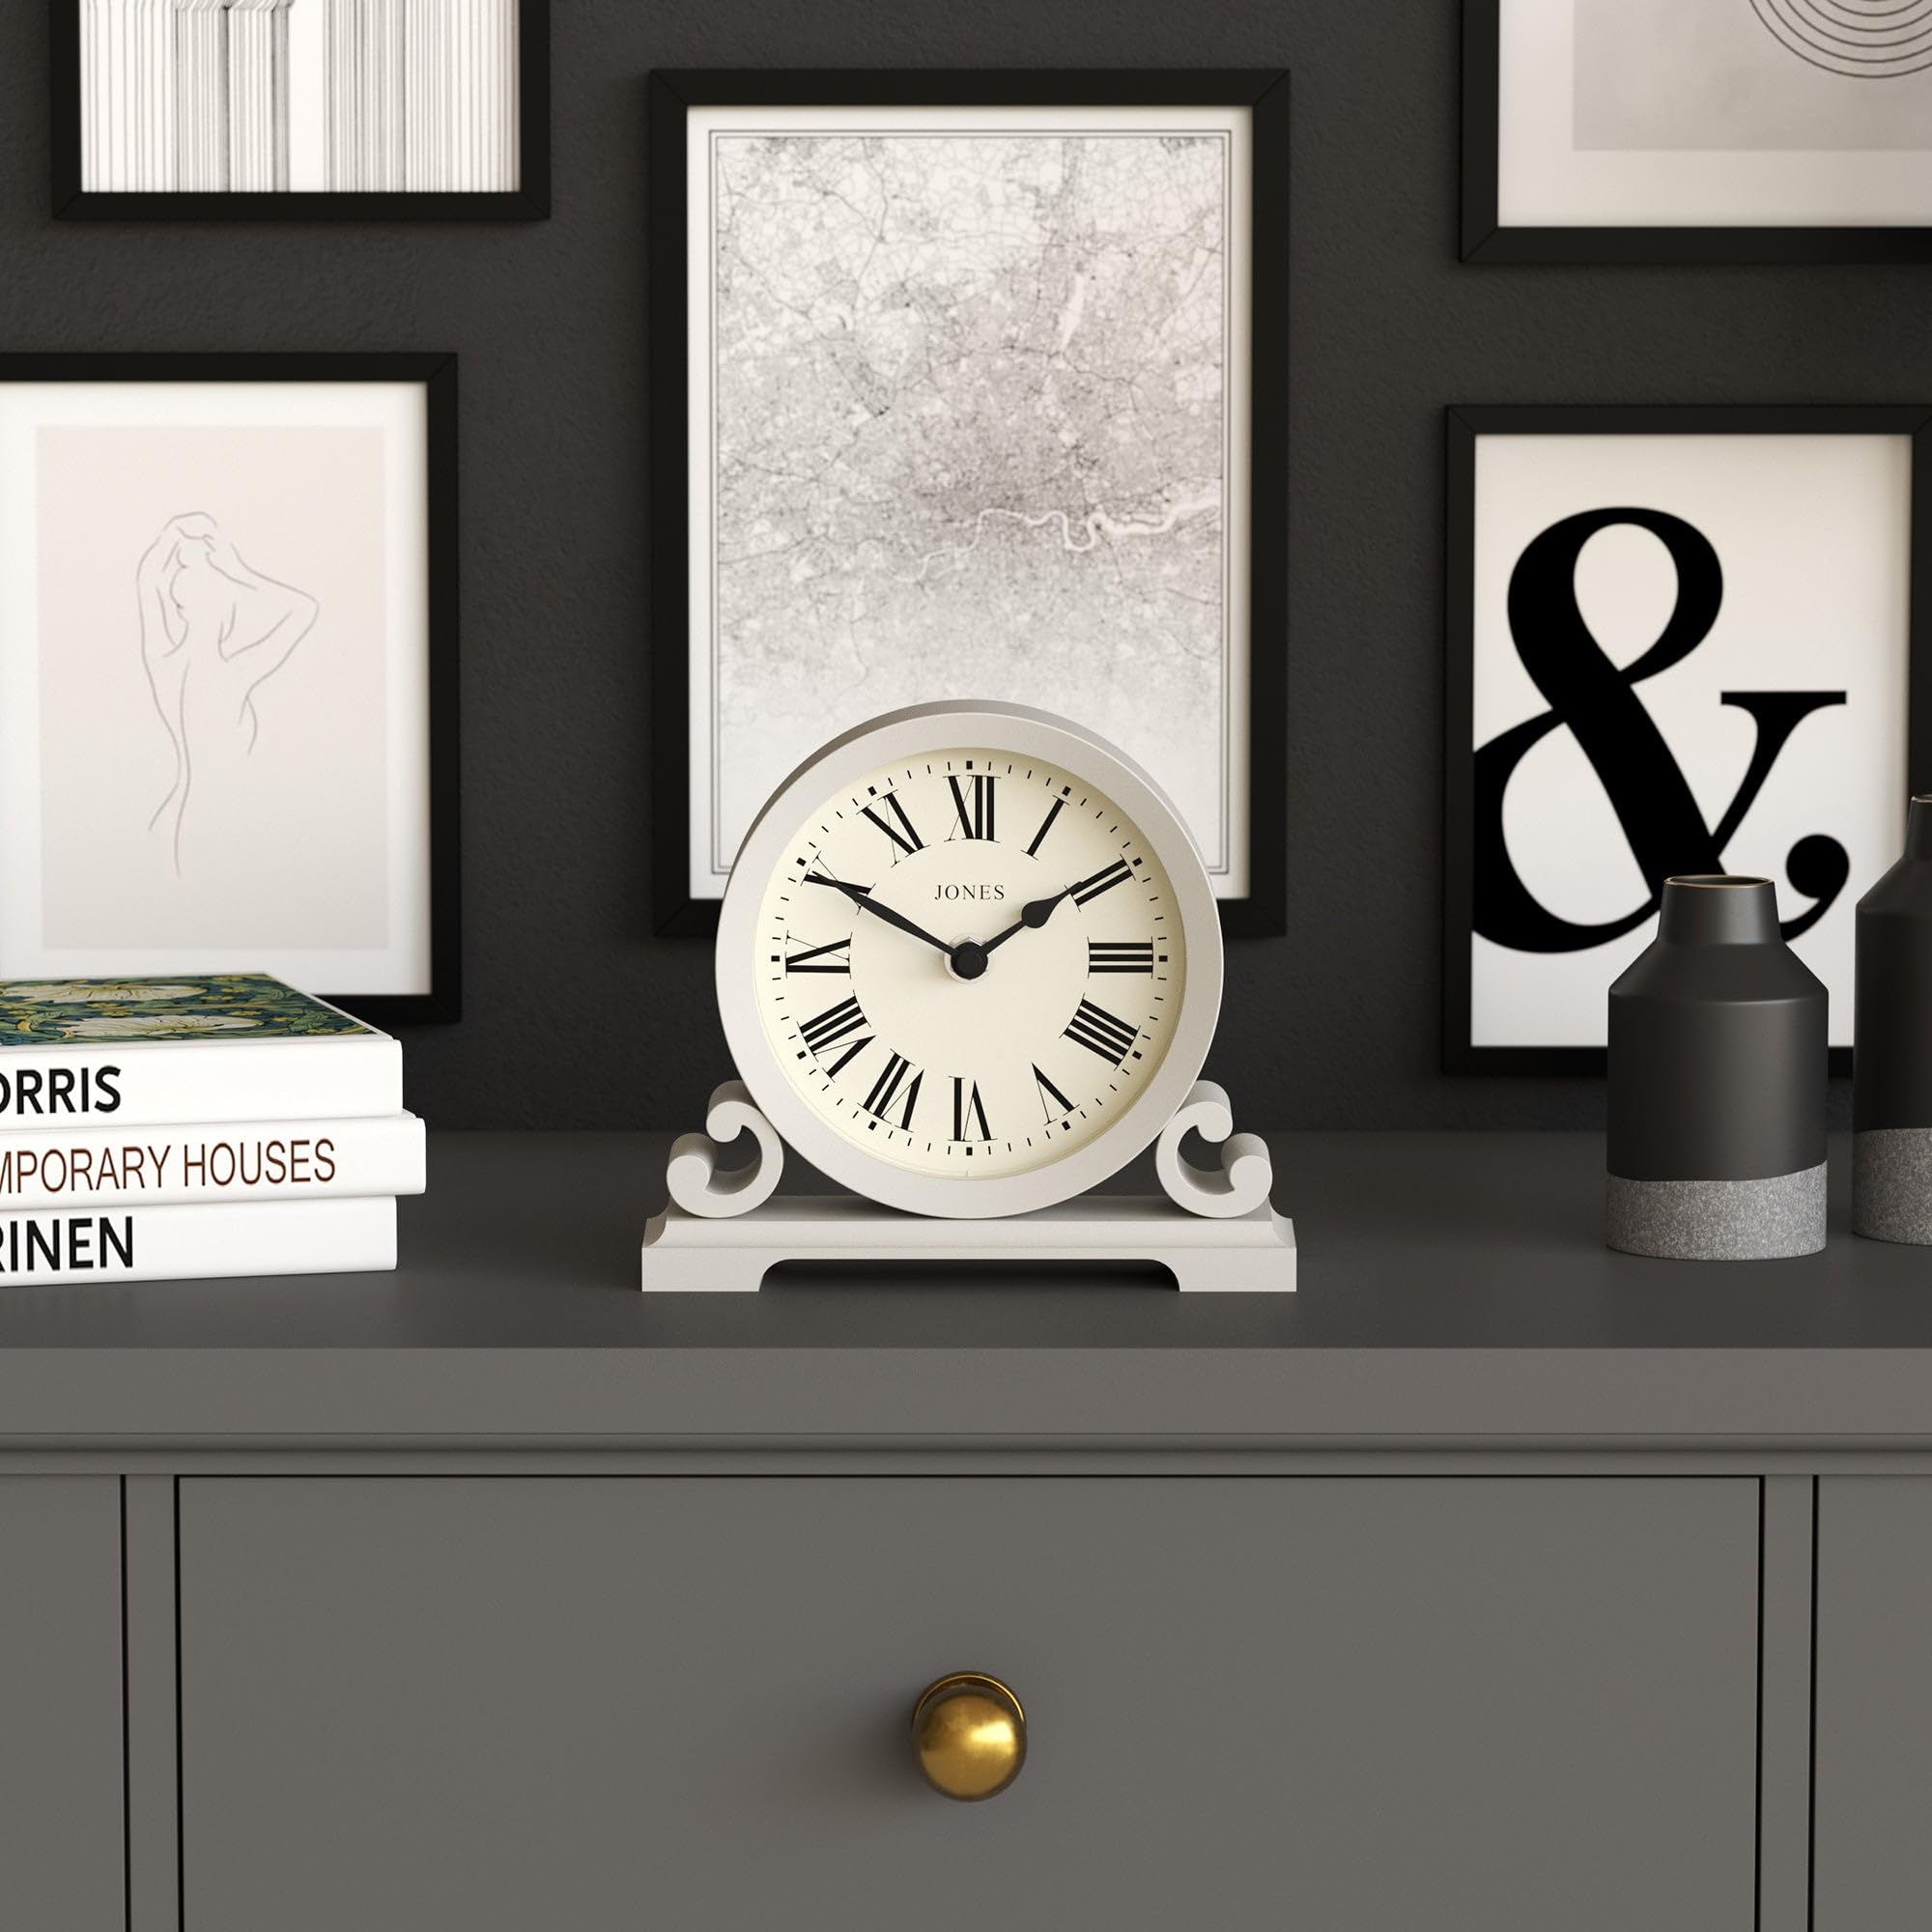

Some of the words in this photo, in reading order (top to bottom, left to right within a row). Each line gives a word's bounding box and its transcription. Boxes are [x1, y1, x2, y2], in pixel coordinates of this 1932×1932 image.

[856, 789, 929, 867] XI
[943, 775, 1001, 843] XII
[1021, 794, 1070, 860] I
[934, 884, 1005, 900] JONES
[1065, 853, 1137, 912] II
[785, 930, 852, 980] IX
[1087, 935, 1154, 980] III
[796, 989, 877, 1083] VIII
[1059, 992, 1141, 1071] IIII
[857, 1048, 924, 1133] VII
[948, 1075, 998, 1143] VI
[1032, 1062, 1081, 1127] V
[184, 1138, 336, 1187] HOUSES
[0, 1215, 133, 1273] INEN
